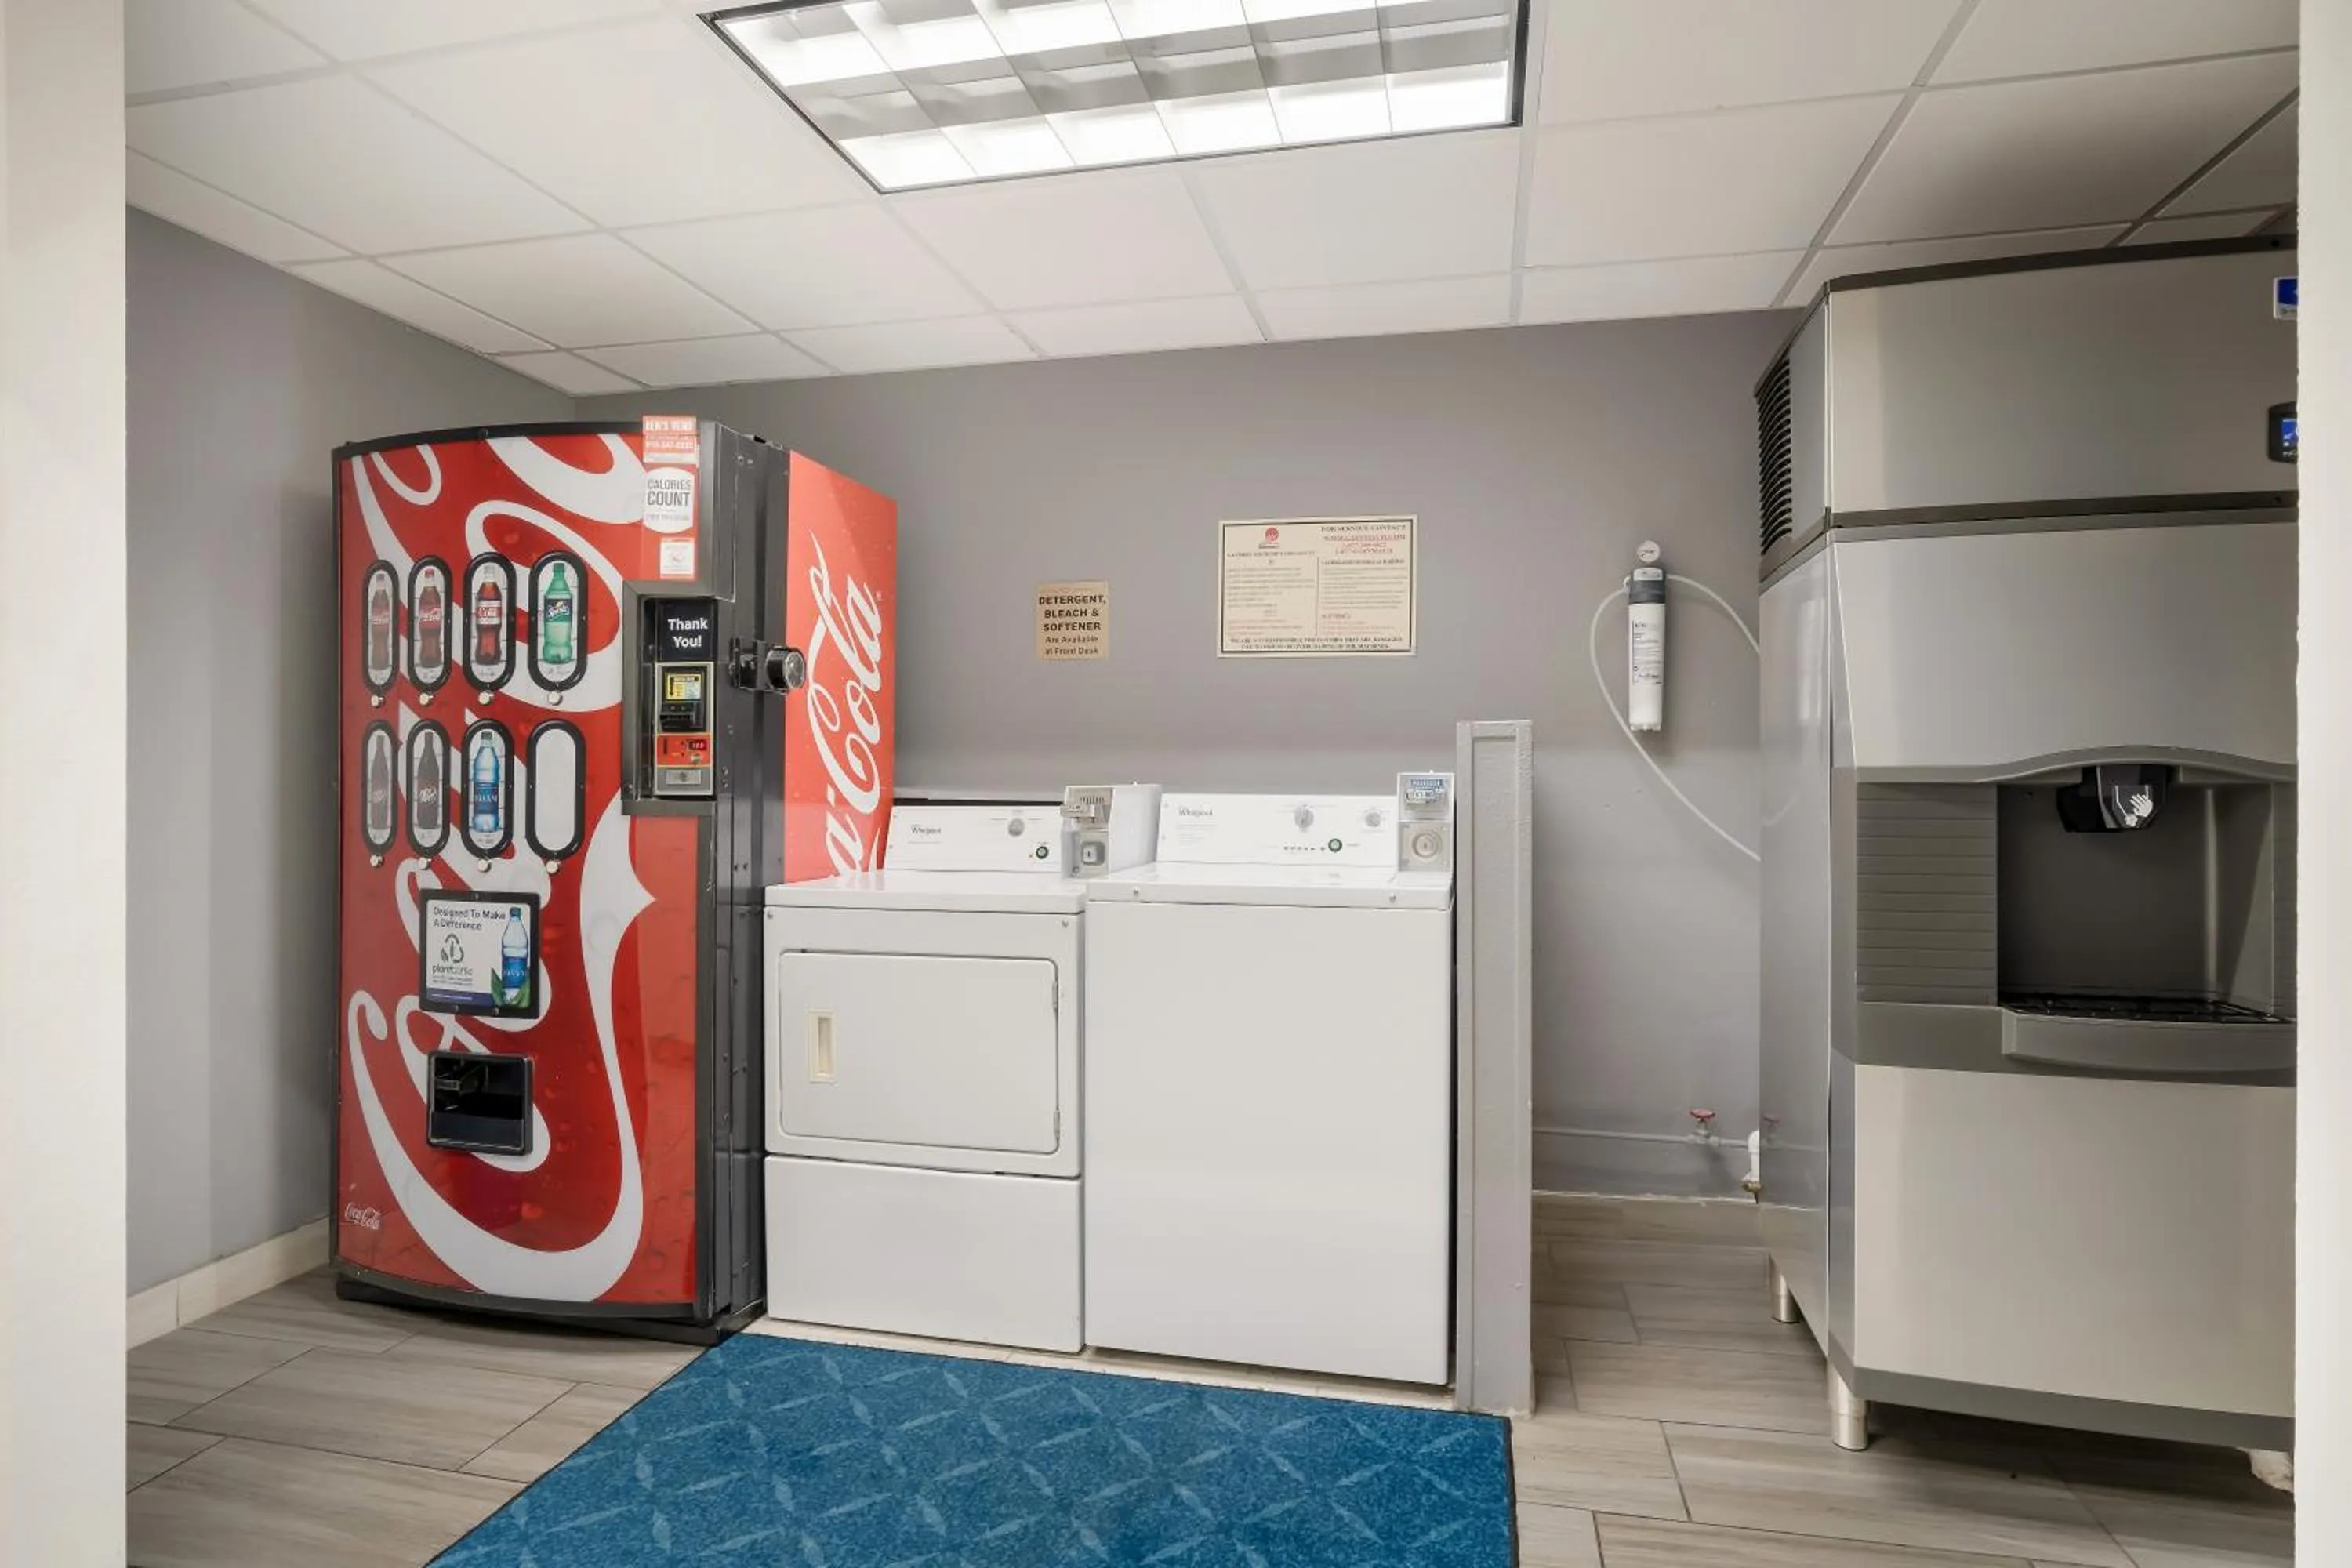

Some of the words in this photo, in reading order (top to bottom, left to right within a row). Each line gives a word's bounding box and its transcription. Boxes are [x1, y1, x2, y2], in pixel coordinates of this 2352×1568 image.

[647, 479, 691, 491] CALORIES
[647, 492, 690, 506] COUNT
[1039, 595, 1106, 604] DETERGENT,
[1044, 608, 1087, 618] BLEACH
[667, 618, 708, 630] Thank
[1044, 622, 1101, 631] SOFTENER
[673, 635, 702, 648] You!
[1078, 645, 1098, 655] Desk
[434, 906, 468, 919] Designed
[470, 909, 480, 918] To
[482, 910, 506, 920] Make
[434, 919, 440, 927] A
[441, 919, 482, 931] Difference
